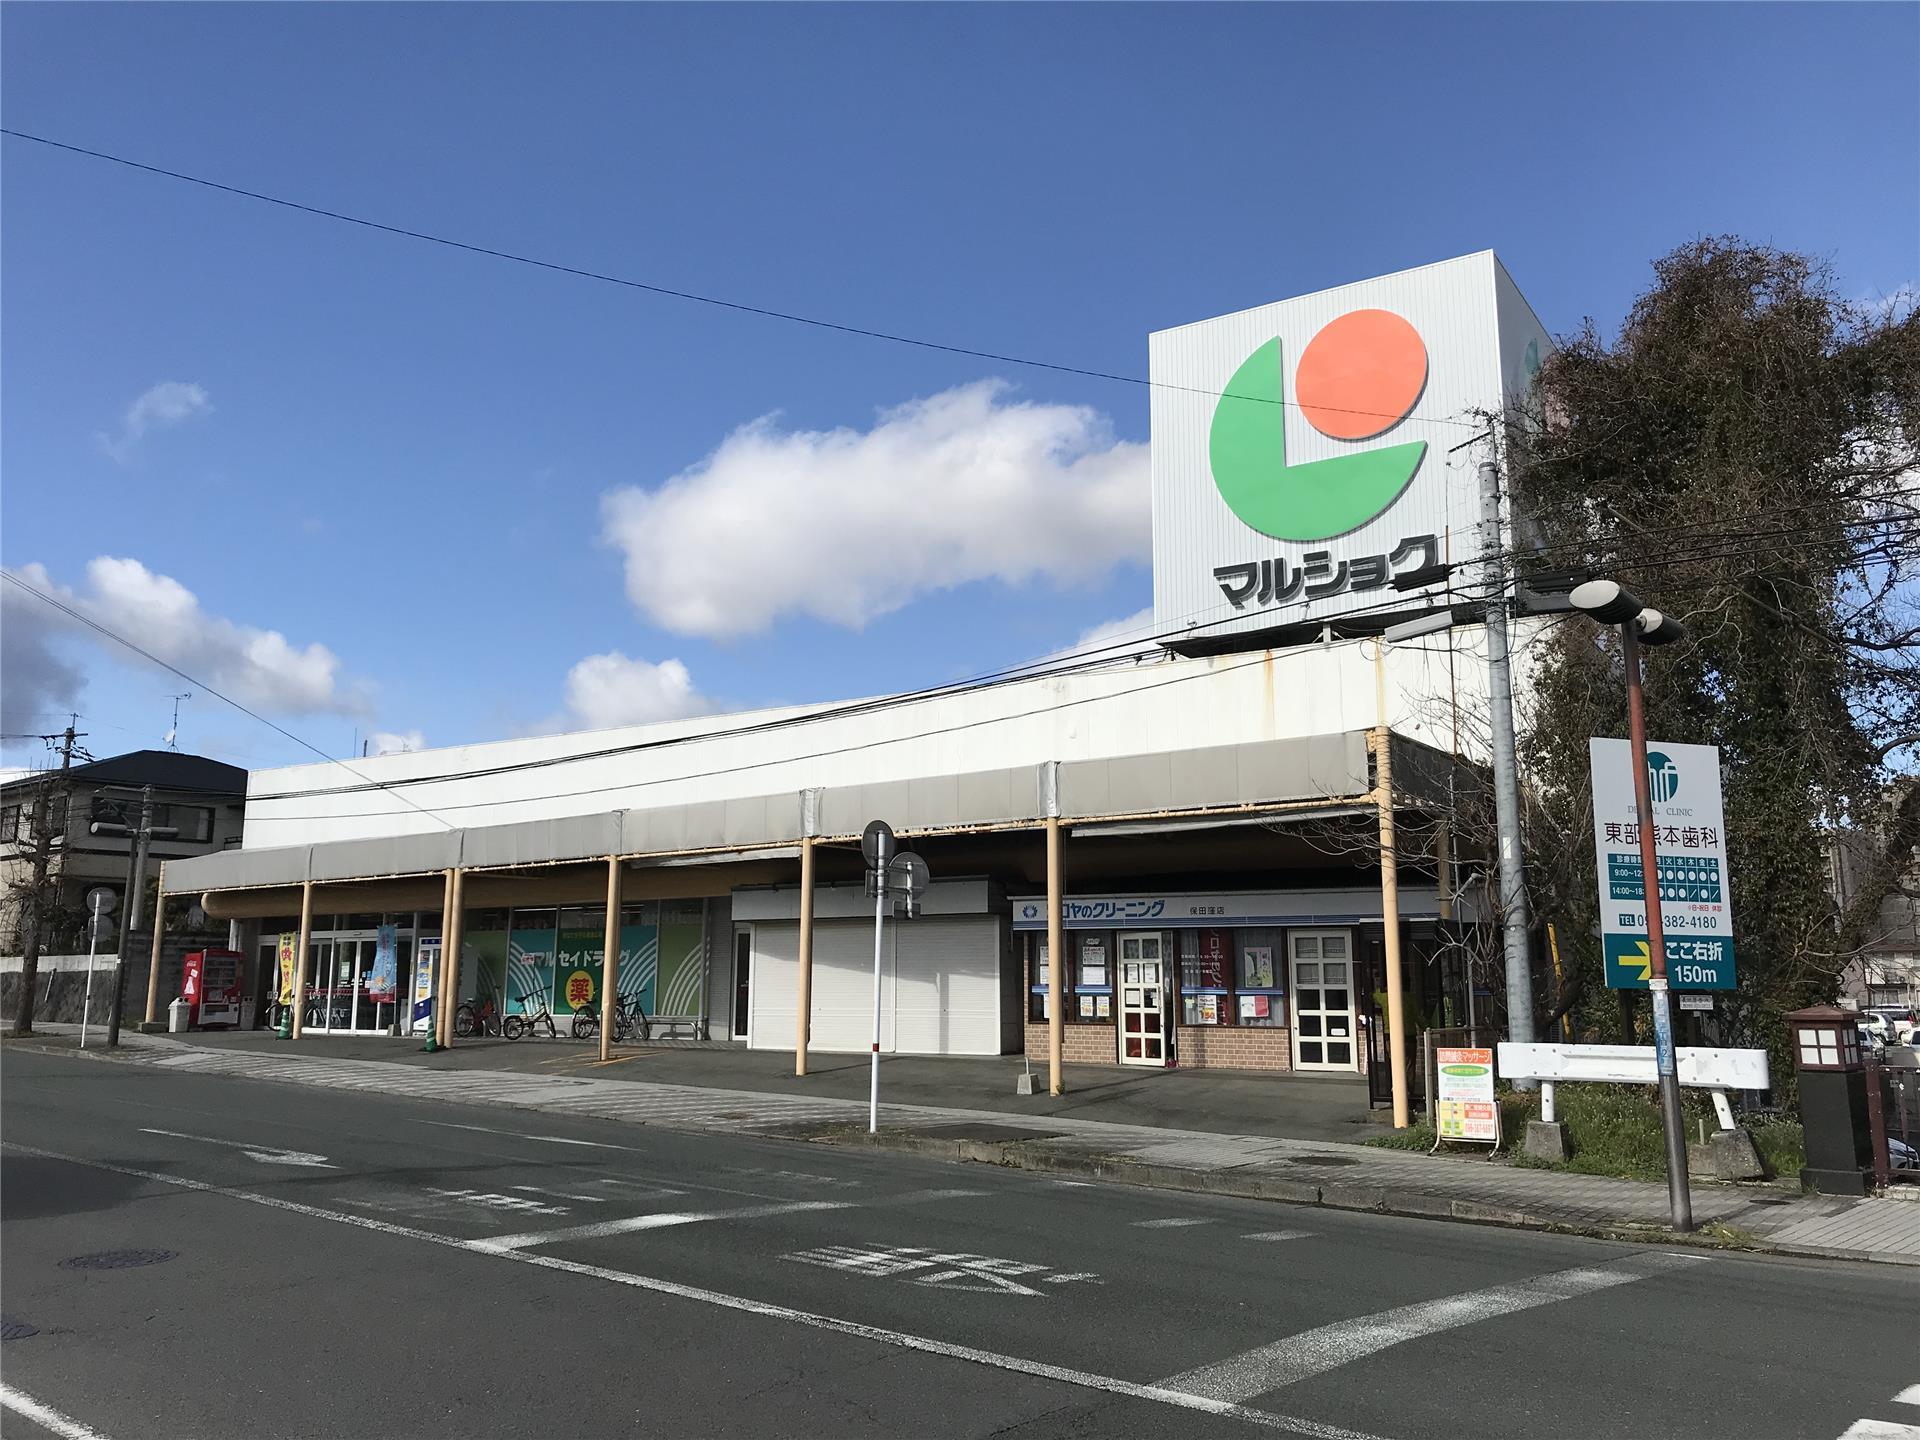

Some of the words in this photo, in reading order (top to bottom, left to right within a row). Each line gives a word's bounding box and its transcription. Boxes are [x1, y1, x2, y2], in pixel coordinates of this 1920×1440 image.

[1213, 534, 1438, 608] マルショク
[1666, 808, 1693, 817] CLINIC
[1666, 858, 1673, 866] 火
[1676, 858, 1684, 866] 水
[1710, 859, 1717, 867] 土
[1062, 899, 1165, 919] ロヤのクリーニング
[1189, 905, 1225, 916] 保田窪店
[1620, 915, 1635, 926] TEL
[1637, 914, 1717, 929] 0-382-4180
[534, 949, 631, 967] マルセイドラグ
[1666, 941, 1723, 961] ここ右折
[1675, 965, 1717, 983] 150m
[570, 978, 590, 1002] 薬
